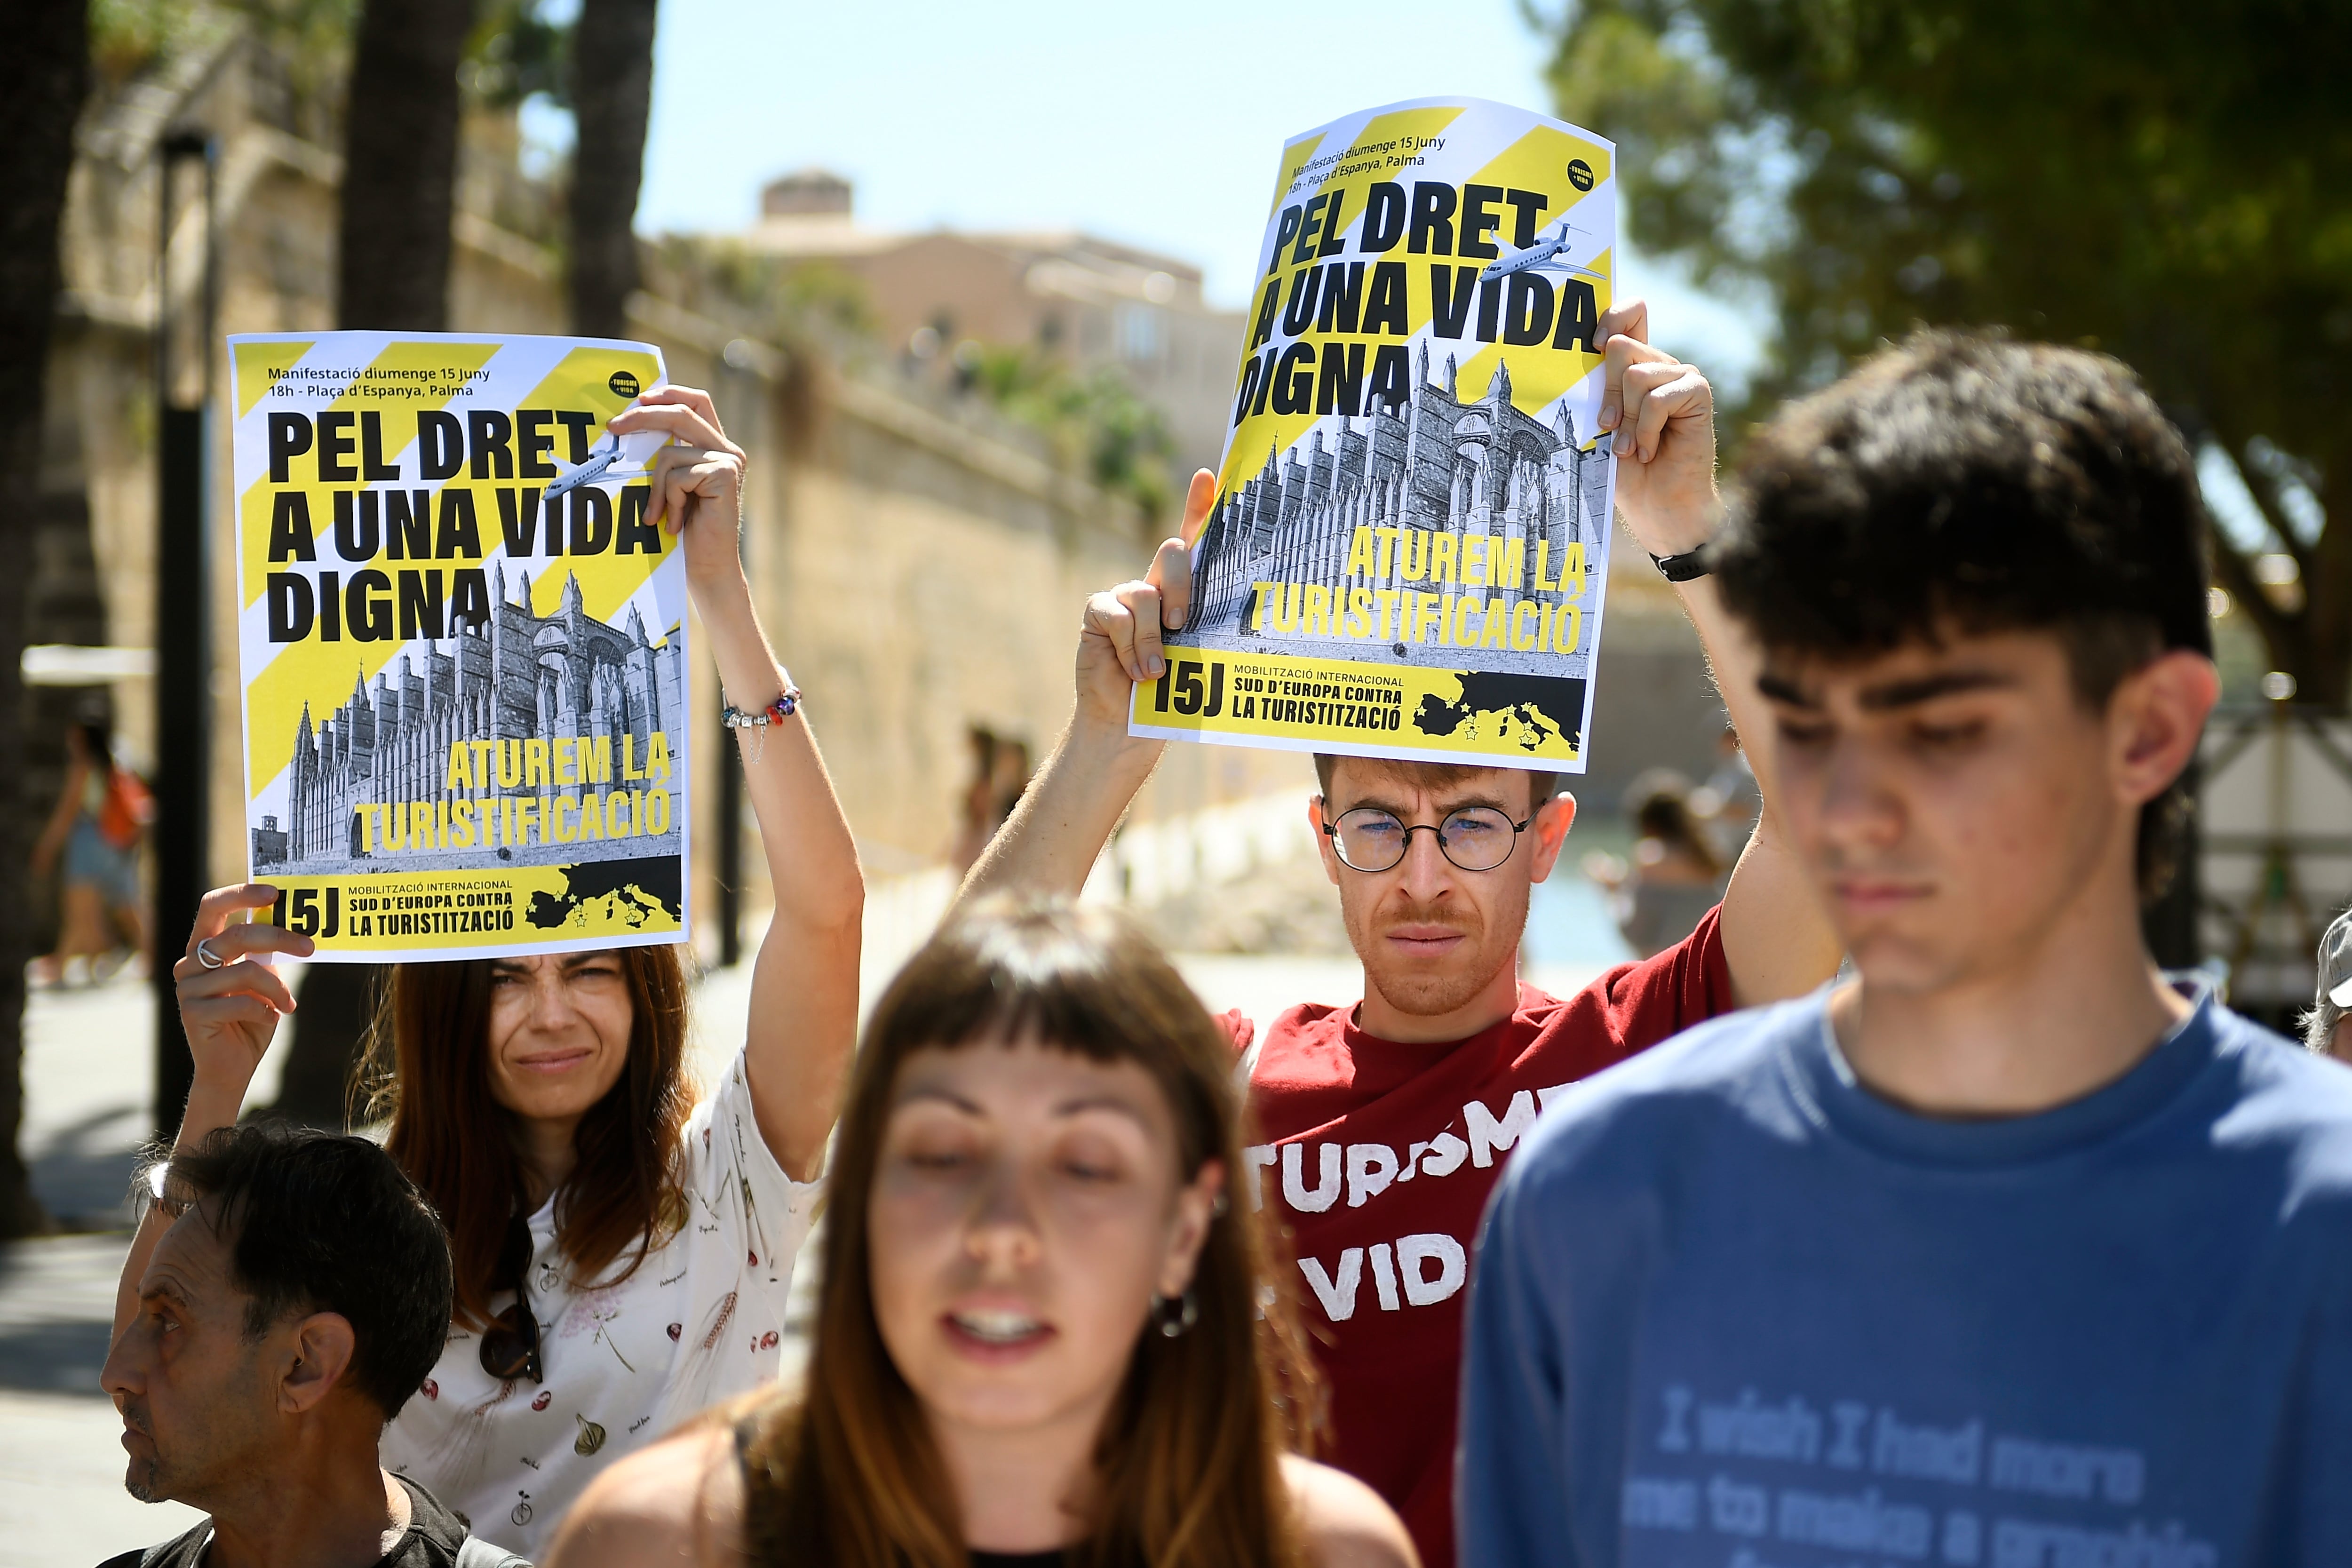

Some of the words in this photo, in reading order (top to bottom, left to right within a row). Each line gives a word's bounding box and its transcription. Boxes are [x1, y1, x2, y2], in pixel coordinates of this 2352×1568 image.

[1289, 181, 1301, 195] 18h
[1308, 173, 1329, 187] Plaça
[1386, 154, 1425, 167] Palma
[1292, 150, 1343, 178] Manifestació
[1346, 141, 1396, 159] diumenge
[1400, 136, 1412, 149] 15
[1414, 135, 1446, 151] Juny
[1269, 184, 1346, 276] PEL
[1359, 179, 1548, 260] DRET
[1251, 278, 1282, 351] A
[1282, 261, 1409, 338] UNA
[1430, 263, 1601, 355] VIDA
[268, 367, 360, 379] Manifestació
[365, 368, 436, 382] diumenge
[440, 368, 455, 379] 15
[458, 368, 490, 382] Juny
[269, 385, 294, 397] 18h
[307, 385, 344, 399] Plaça
[430, 385, 473, 396] Palma
[1233, 342, 1411, 429] DIGNA
[268, 411, 401, 483] PEL
[417, 410, 595, 481] DRET
[268, 491, 316, 562] A
[333, 488, 482, 562] UNA
[495, 486, 662, 557] VIDA
[1346, 525, 1524, 589] ATUREM
[1535, 539, 1587, 595] LA
[267, 568, 492, 643] DIGNA
[1251, 581, 1582, 655] TURISTIFICACIÓ
[1154, 659, 1225, 718] 15J
[1234, 664, 1313, 680] MOBILITZACIÓ
[1317, 671, 1405, 687] INTERNACIONAL
[1234, 677, 1263, 693] SUD
[1268, 680, 1340, 700] D’EUROPA
[1344, 687, 1402, 705] CONTRA
[1232, 695, 1255, 719] LA
[1261, 697, 1401, 732] TURISTITZACIÓ
[447, 735, 610, 790] ATUREM
[623, 732, 671, 781] LA
[355, 777, 671, 852] TURISTIFICACIÓ
[348, 881, 424, 895] MOBILITZACIÓ
[427, 880, 513, 891] INTERNACIONAL
[349, 898, 378, 912] SUD
[382, 894, 452, 911] D’EUROPA
[456, 892, 513, 907] CONTRA
[349, 915, 372, 937] LA
[377, 907, 514, 936] TURISTITZACIÓ
[1657, 1386, 1691, 1452] I
[1698, 1387, 1820, 1464] wish
[1828, 1400, 1869, 1469] I
[1872, 1405, 1983, 1482] had
[1990, 1436, 2143, 1504] more
[1709, 1473, 1768, 1537] to
[1777, 1486, 1930, 1559] make
[1943, 1509, 1978, 1565] a
